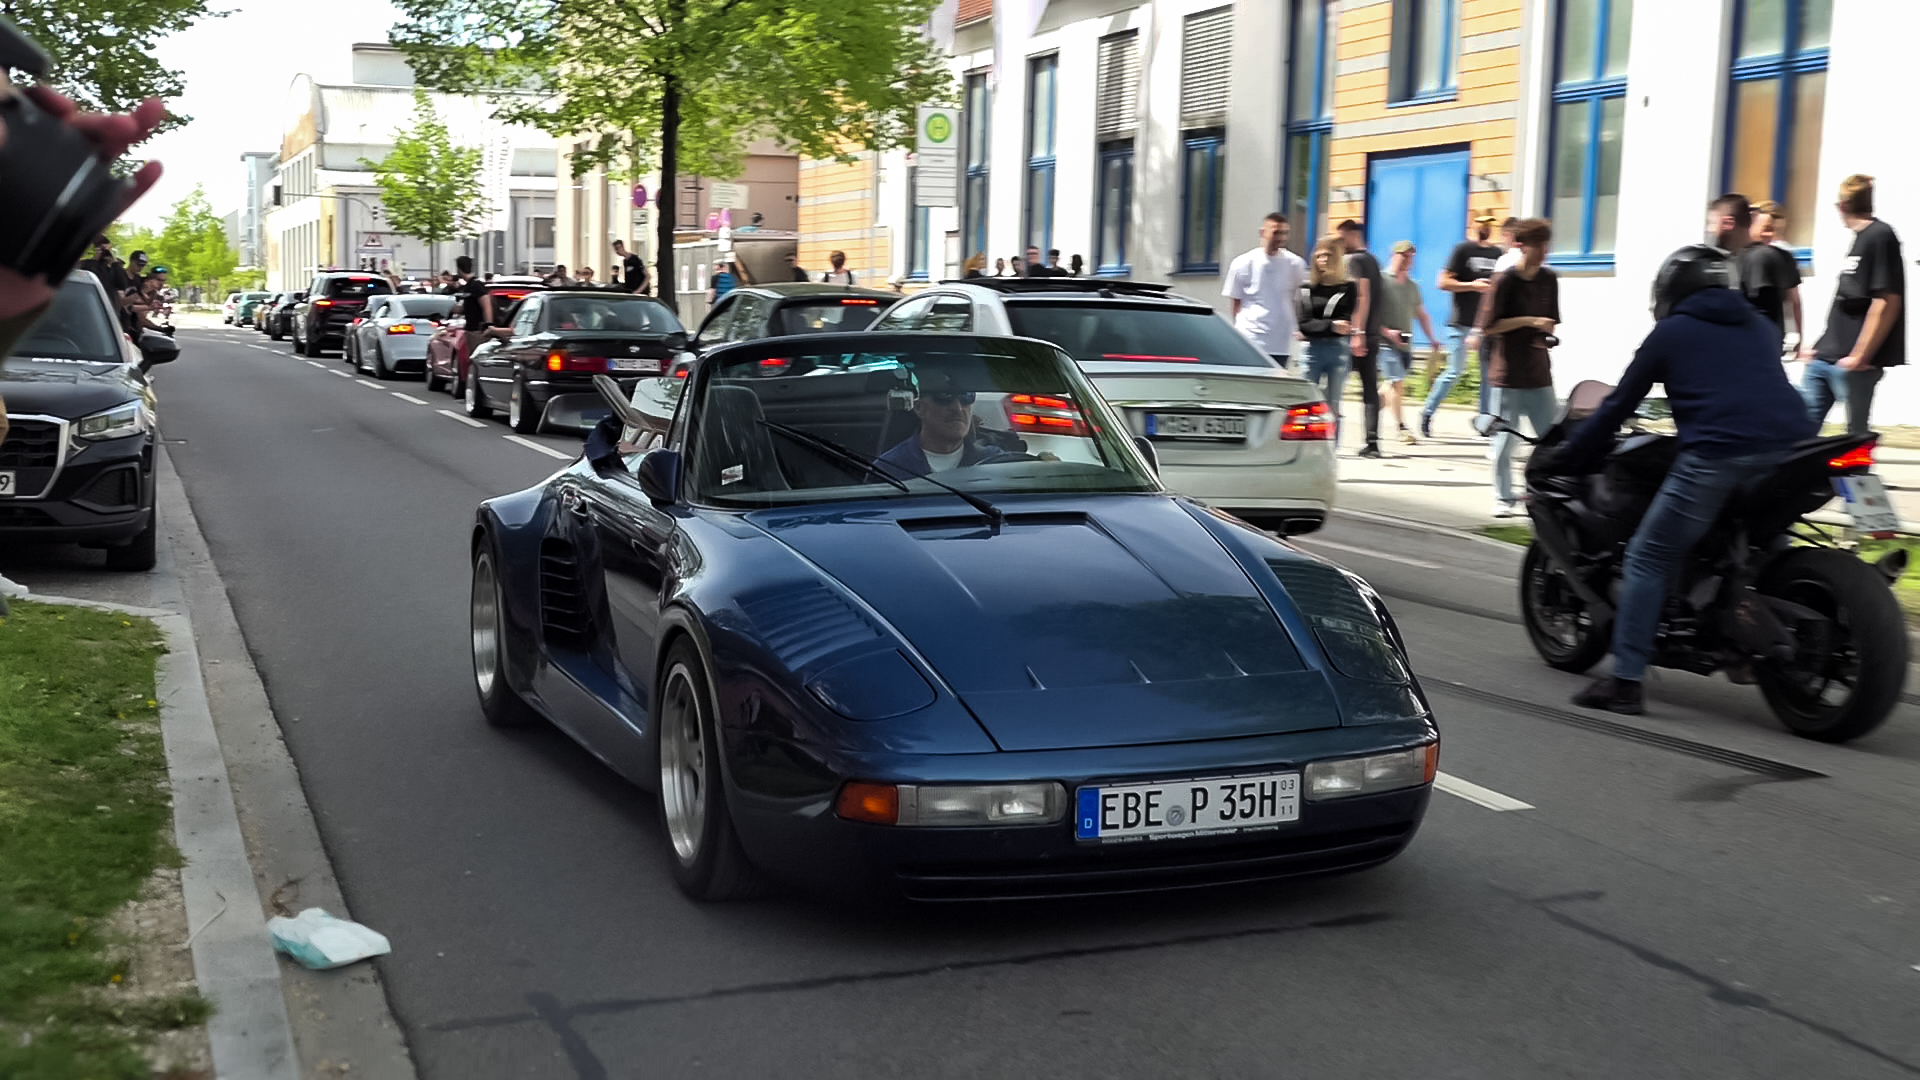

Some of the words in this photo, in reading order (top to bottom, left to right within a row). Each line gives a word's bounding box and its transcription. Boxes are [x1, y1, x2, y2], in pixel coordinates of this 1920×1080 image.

[1280, 779, 1295, 790] 03
[1101, 790, 1163, 831] EBE
[1191, 787, 1209, 824] P
[1219, 780, 1277, 821] 35H
[1281, 804, 1293, 815] 11
[1084, 817, 1093, 829] D
